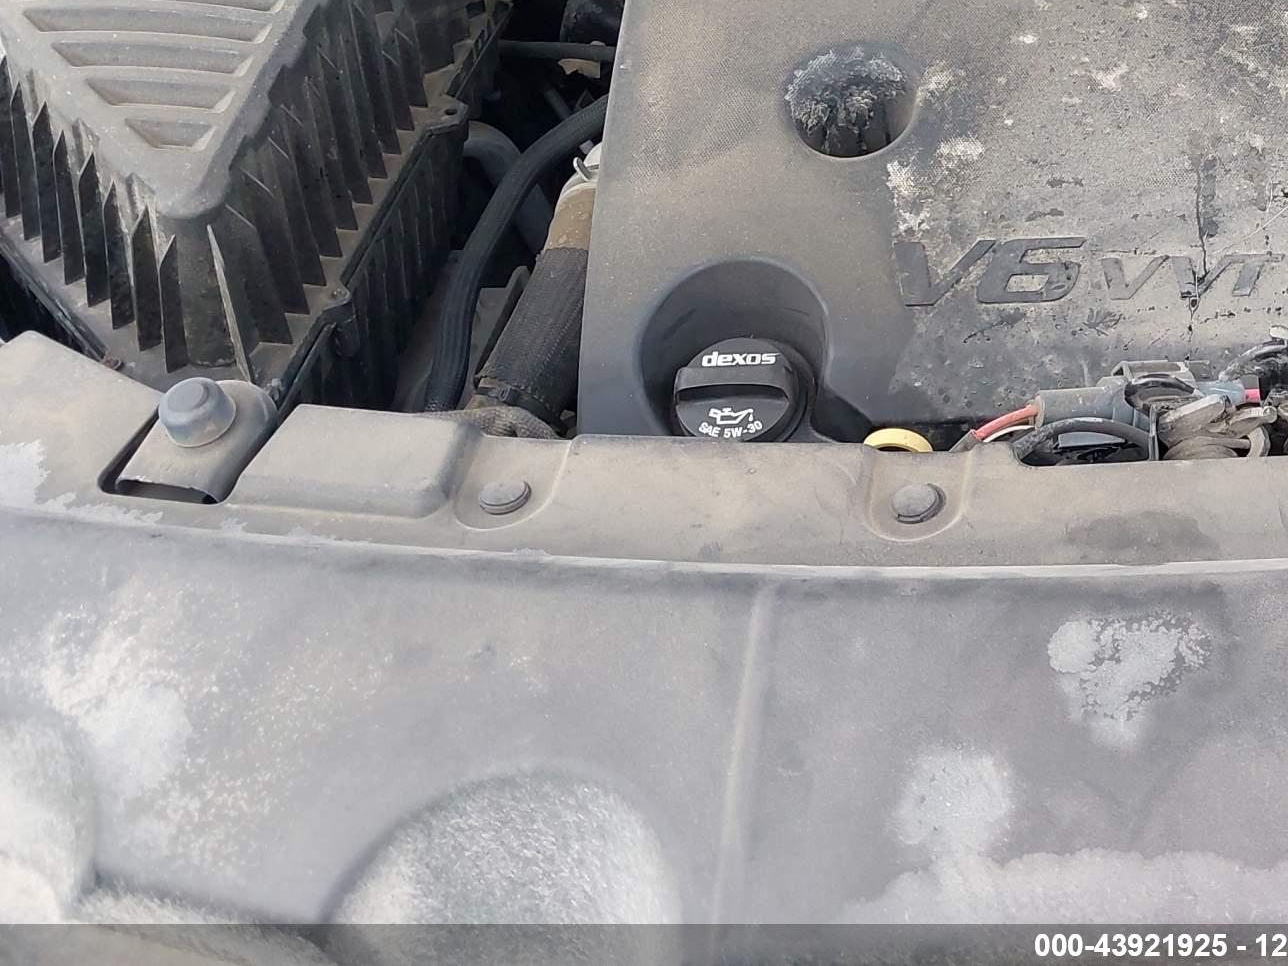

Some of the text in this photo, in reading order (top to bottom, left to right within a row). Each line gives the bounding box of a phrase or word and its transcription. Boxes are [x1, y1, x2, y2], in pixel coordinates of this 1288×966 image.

[894, 236, 1286, 306] V6 VVT
[701, 351, 781, 367] dexos
[698, 421, 763, 439] SAE 5W-30
